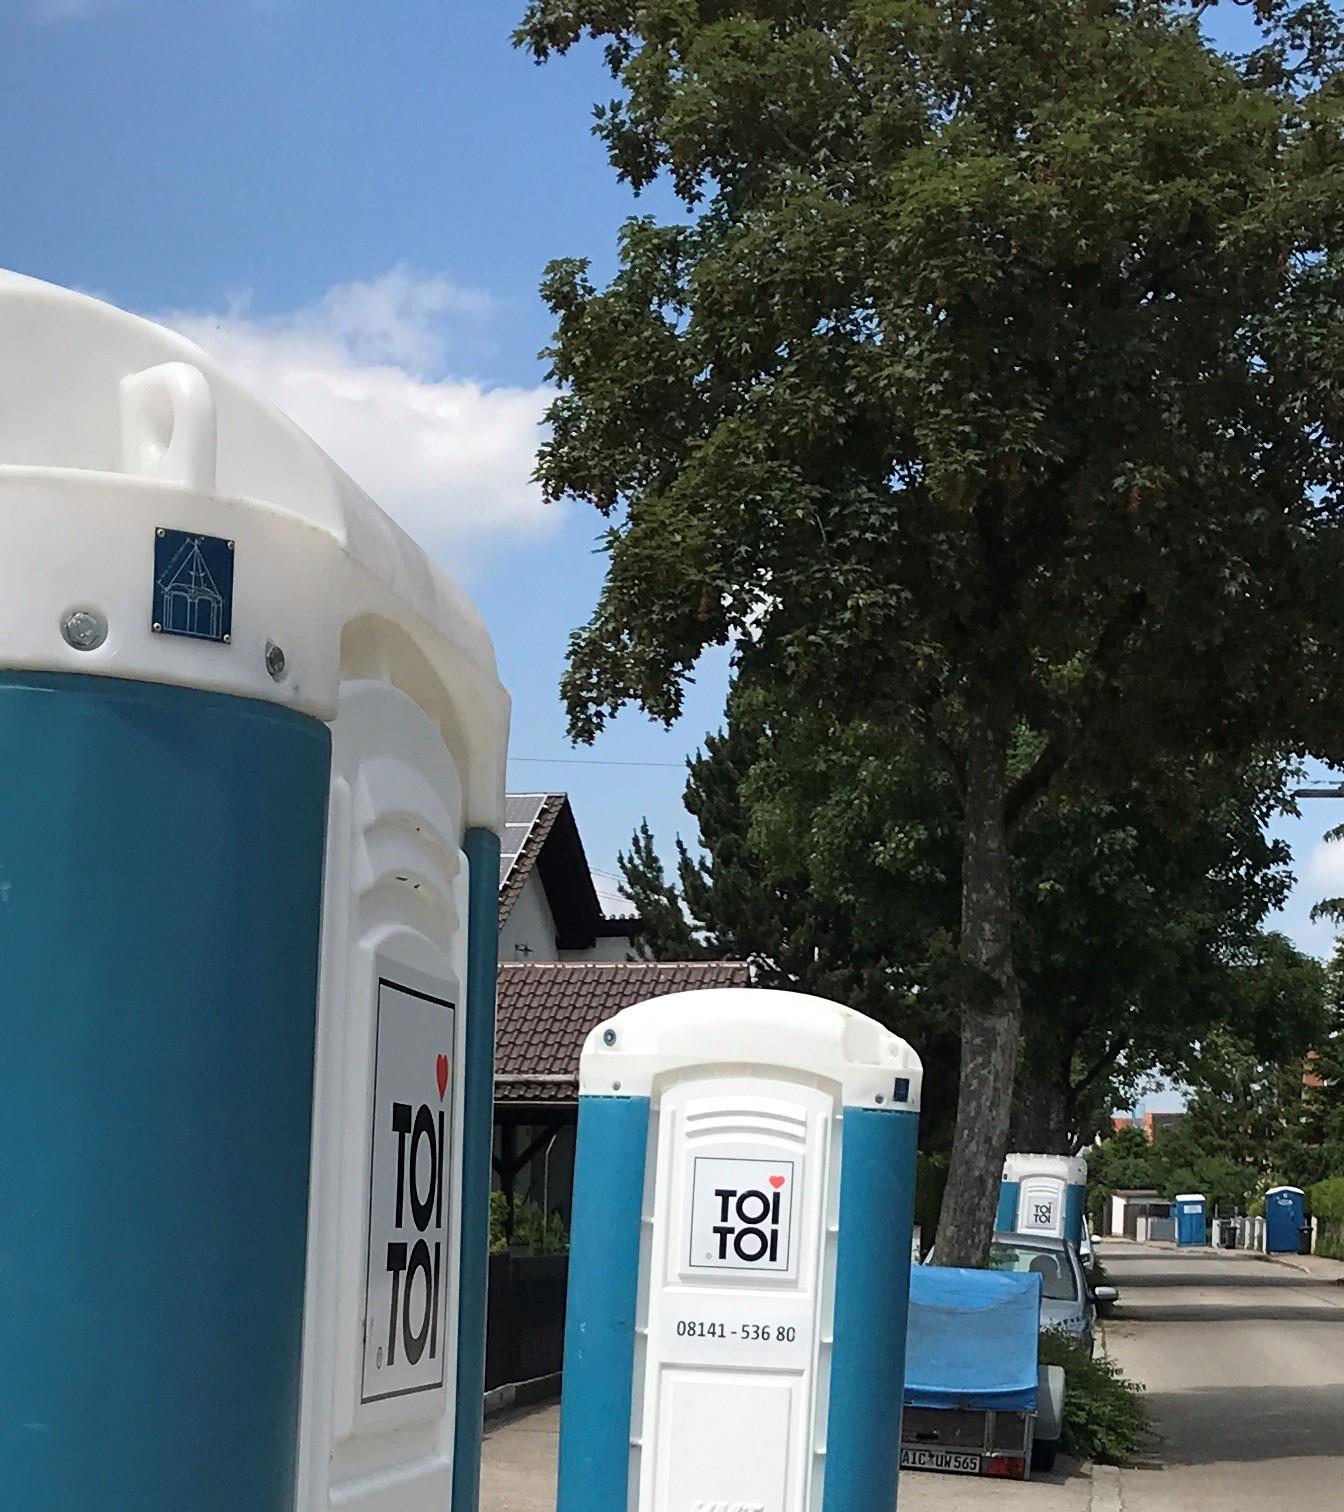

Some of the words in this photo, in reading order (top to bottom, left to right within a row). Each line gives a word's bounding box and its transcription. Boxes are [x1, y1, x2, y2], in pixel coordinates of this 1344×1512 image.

[393, 1102, 445, 1233] TOI
[714, 1188, 781, 1225] TOI
[1033, 1214, 1050, 1223] TOI
[712, 1226, 779, 1262] TOI
[387, 1238, 441, 1366] TOI
[676, 1320, 726, 1338] 08141
[741, 1324, 771, 1341] 536
[776, 1326, 796, 1343] 80
[902, 1451, 926, 1465] AIC
[954, 1456, 977, 1470] 565
